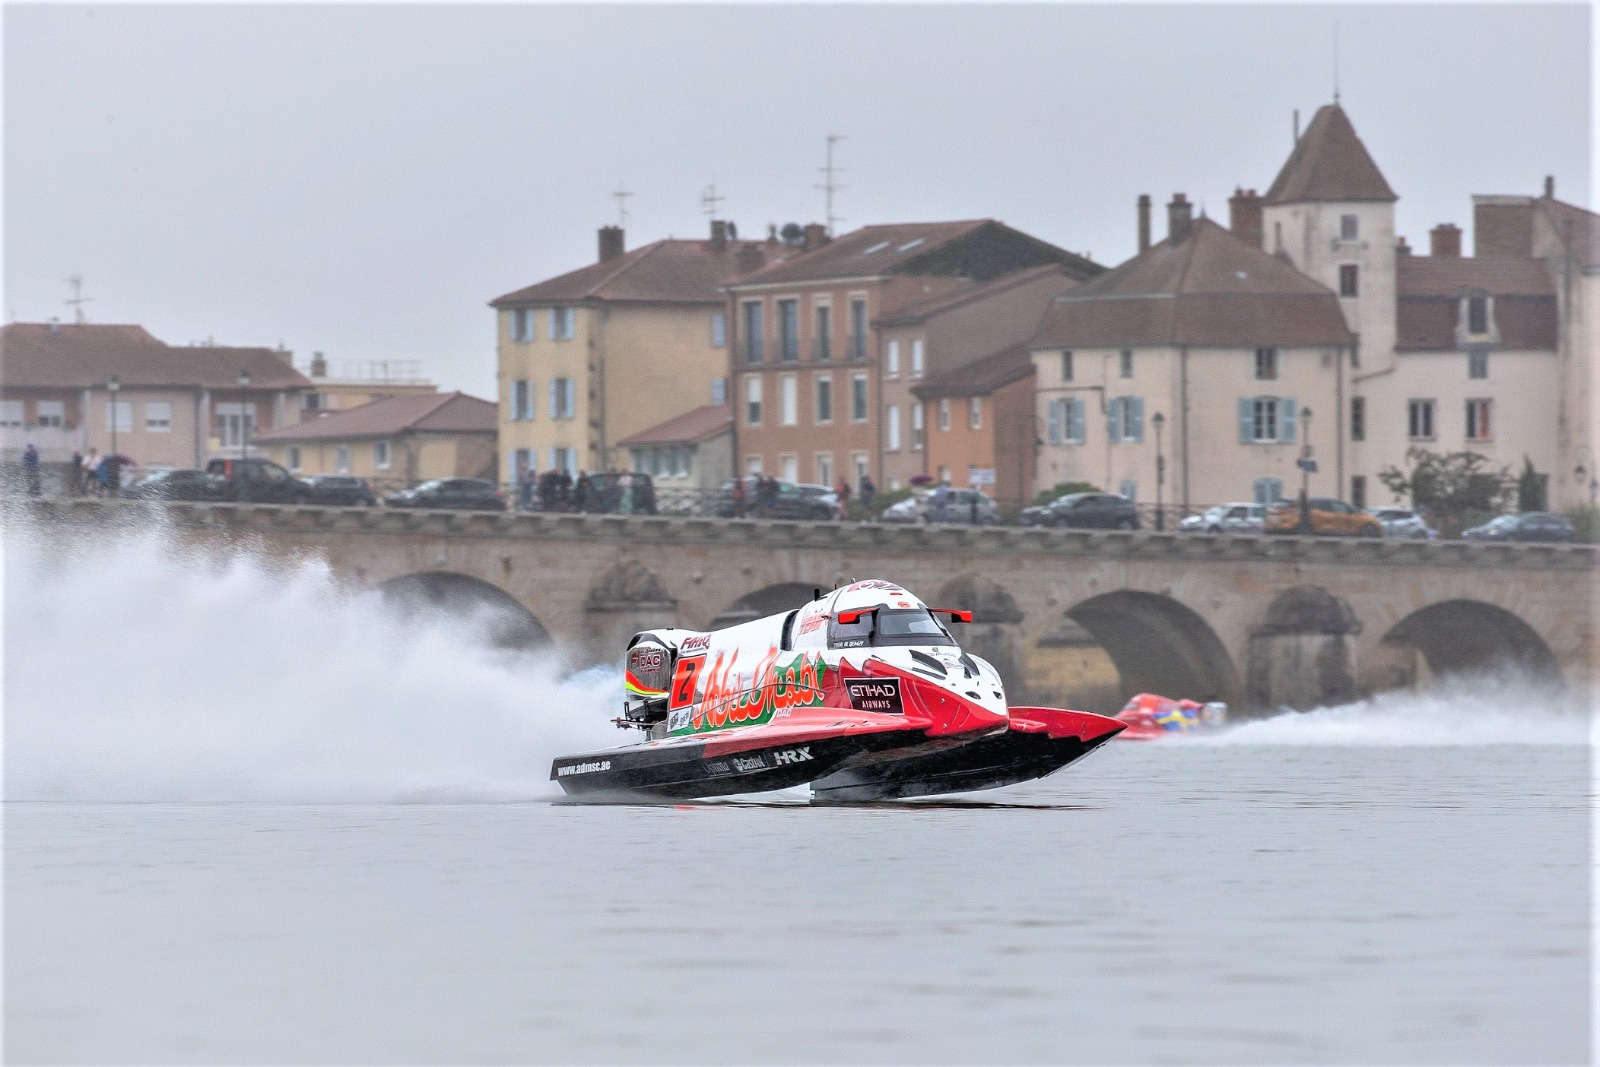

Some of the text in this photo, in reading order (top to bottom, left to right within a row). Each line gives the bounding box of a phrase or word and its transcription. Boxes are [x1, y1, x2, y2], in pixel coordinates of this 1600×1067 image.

[640, 654, 661, 668] DAC
[678, 662, 696, 702] 2
[850, 684, 896, 697] ETIHAD
[862, 700, 891, 709] AIRWAYS
[773, 746, 815, 766] HRX
[557, 760, 611, 777] www.admsc.ae
